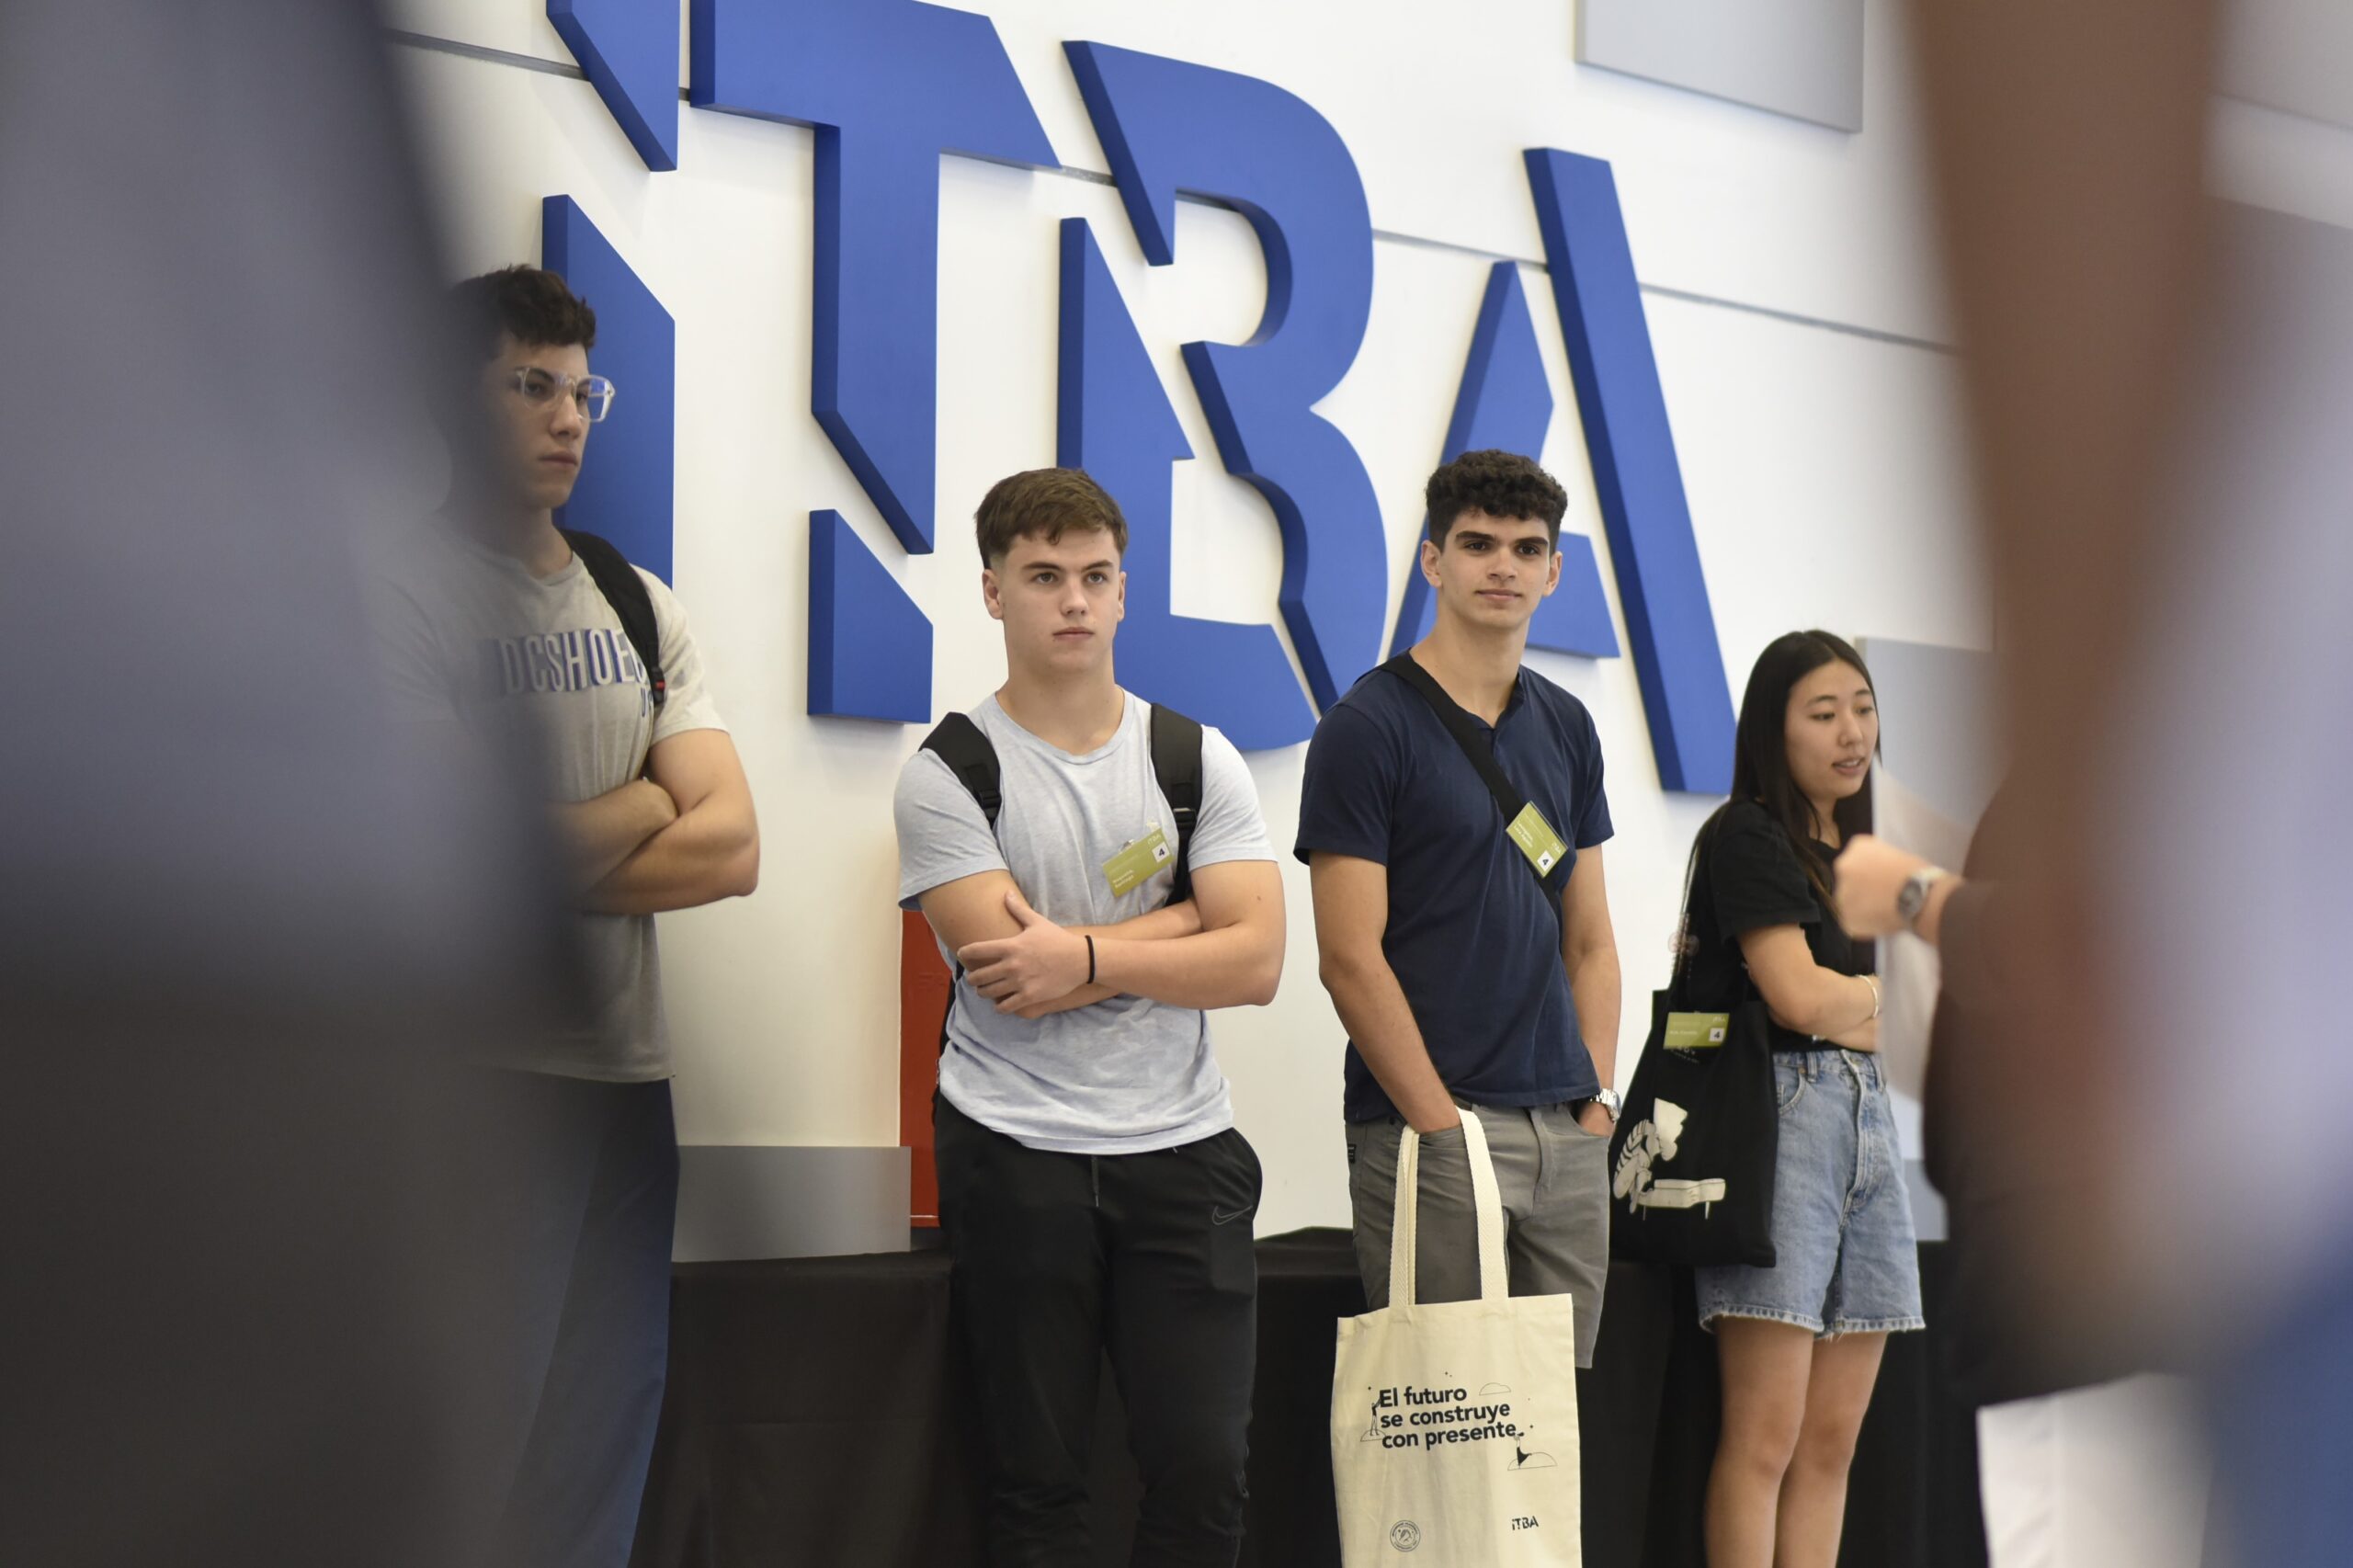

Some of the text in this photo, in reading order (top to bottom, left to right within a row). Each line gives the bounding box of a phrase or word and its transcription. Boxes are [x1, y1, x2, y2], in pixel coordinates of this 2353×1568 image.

[1714, 1031, 1720, 1040] 4
[1380, 1386, 1467, 1408] El futuro
[1381, 1403, 1510, 1428] se construye
[1381, 1432, 1419, 1449] con
